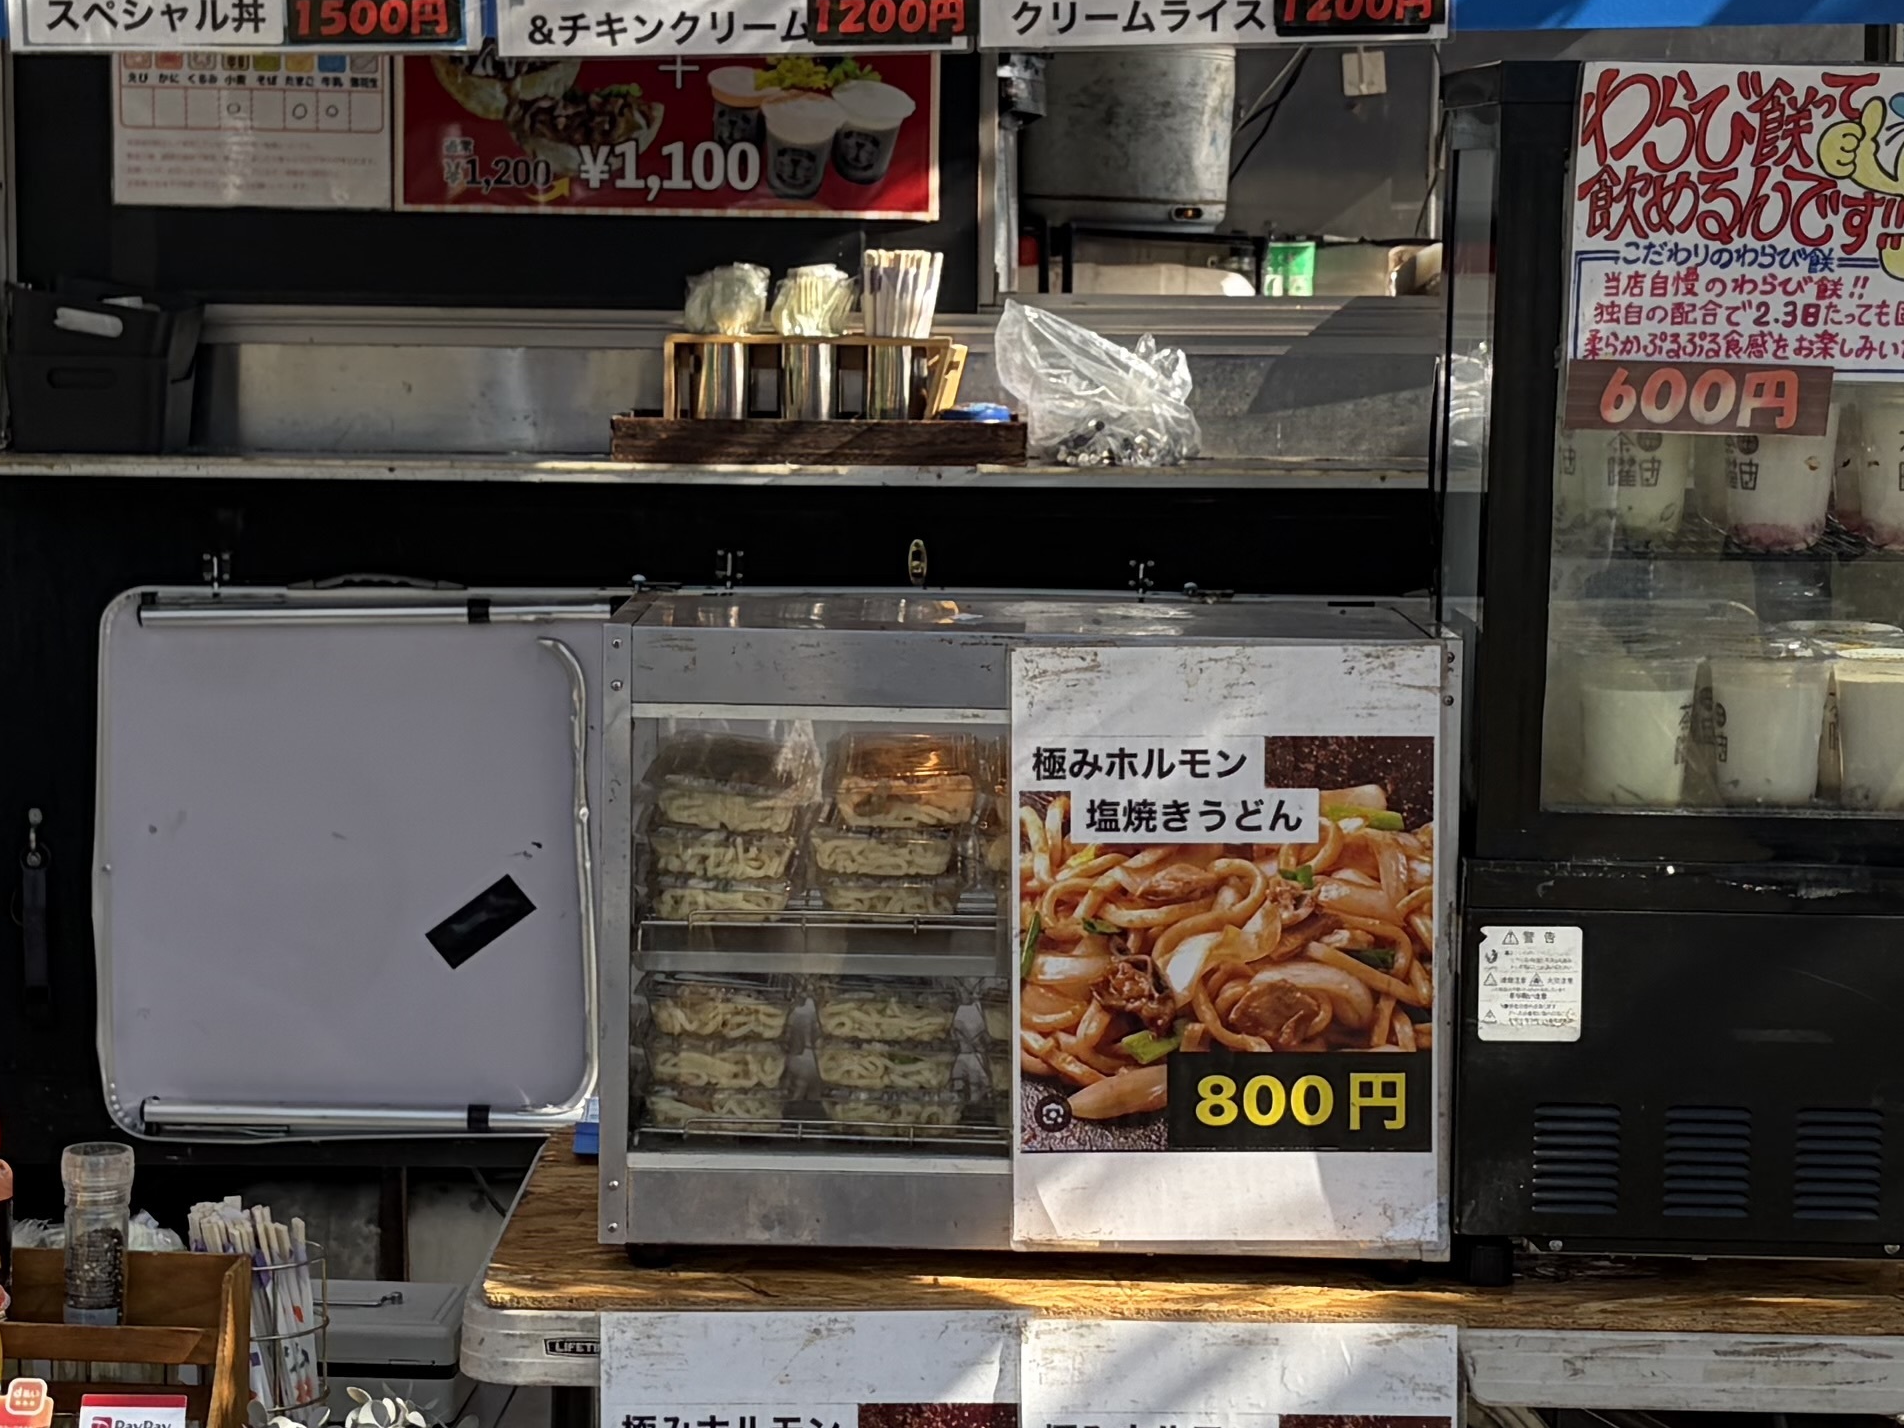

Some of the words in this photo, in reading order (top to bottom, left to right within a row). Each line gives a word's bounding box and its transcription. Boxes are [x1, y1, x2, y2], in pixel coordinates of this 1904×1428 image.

[527, 6, 810, 48] &チキンクリーム
[444, 156, 554, 189] ¥1,200
[578, 141, 761, 192] ¥1,100
[1599, 366, 1801, 430] 600円
[1032, 745, 1248, 780] 極みホルモン
[1086, 798, 1303, 834] 塩焼きうどん
[1195, 1071, 1407, 1131] 800円
